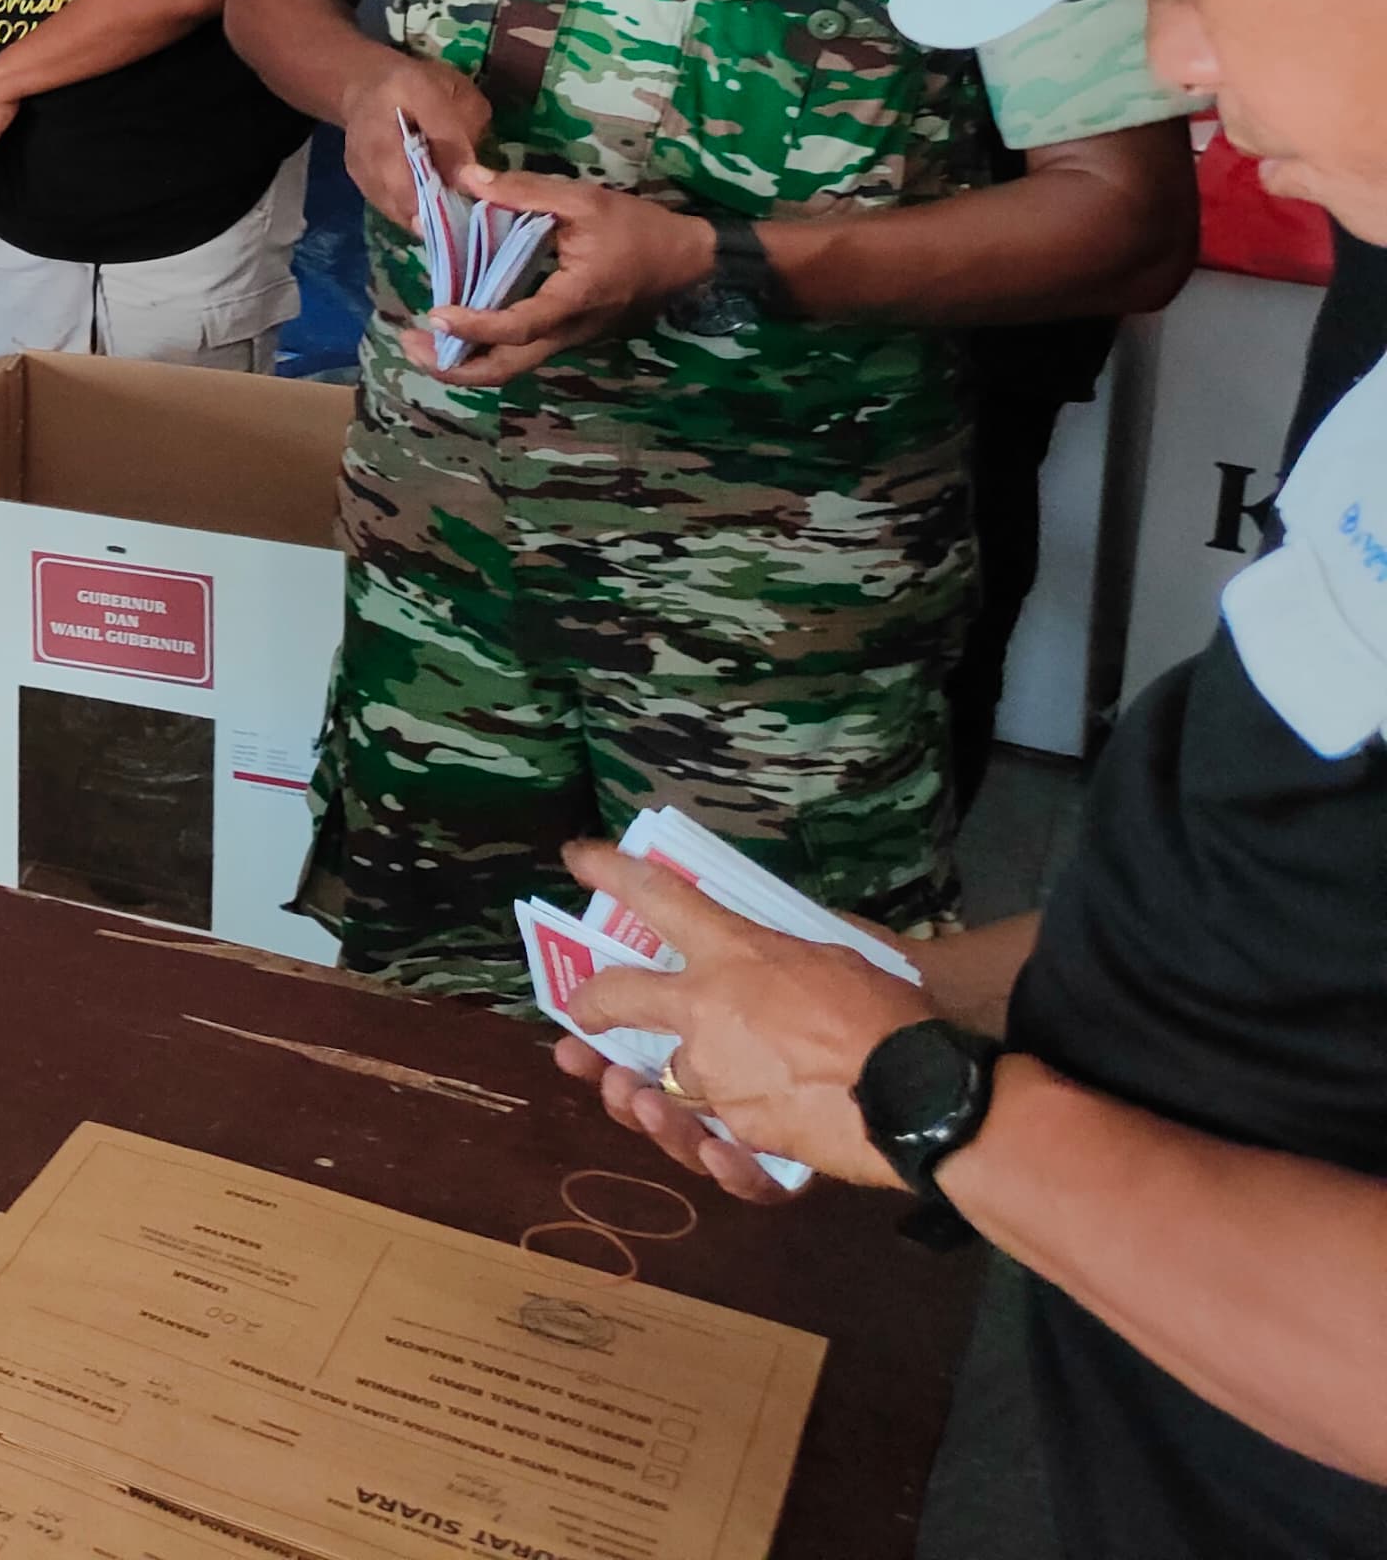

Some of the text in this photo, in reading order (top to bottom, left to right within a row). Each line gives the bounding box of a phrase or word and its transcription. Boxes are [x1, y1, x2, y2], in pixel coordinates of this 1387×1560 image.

[76, 589, 167, 615] GUBERNUR
[104, 611, 139, 628] DAN
[49, 621, 197, 656] WAKIL GUBERNUR
[344, 1485, 469, 1535] SUARA
